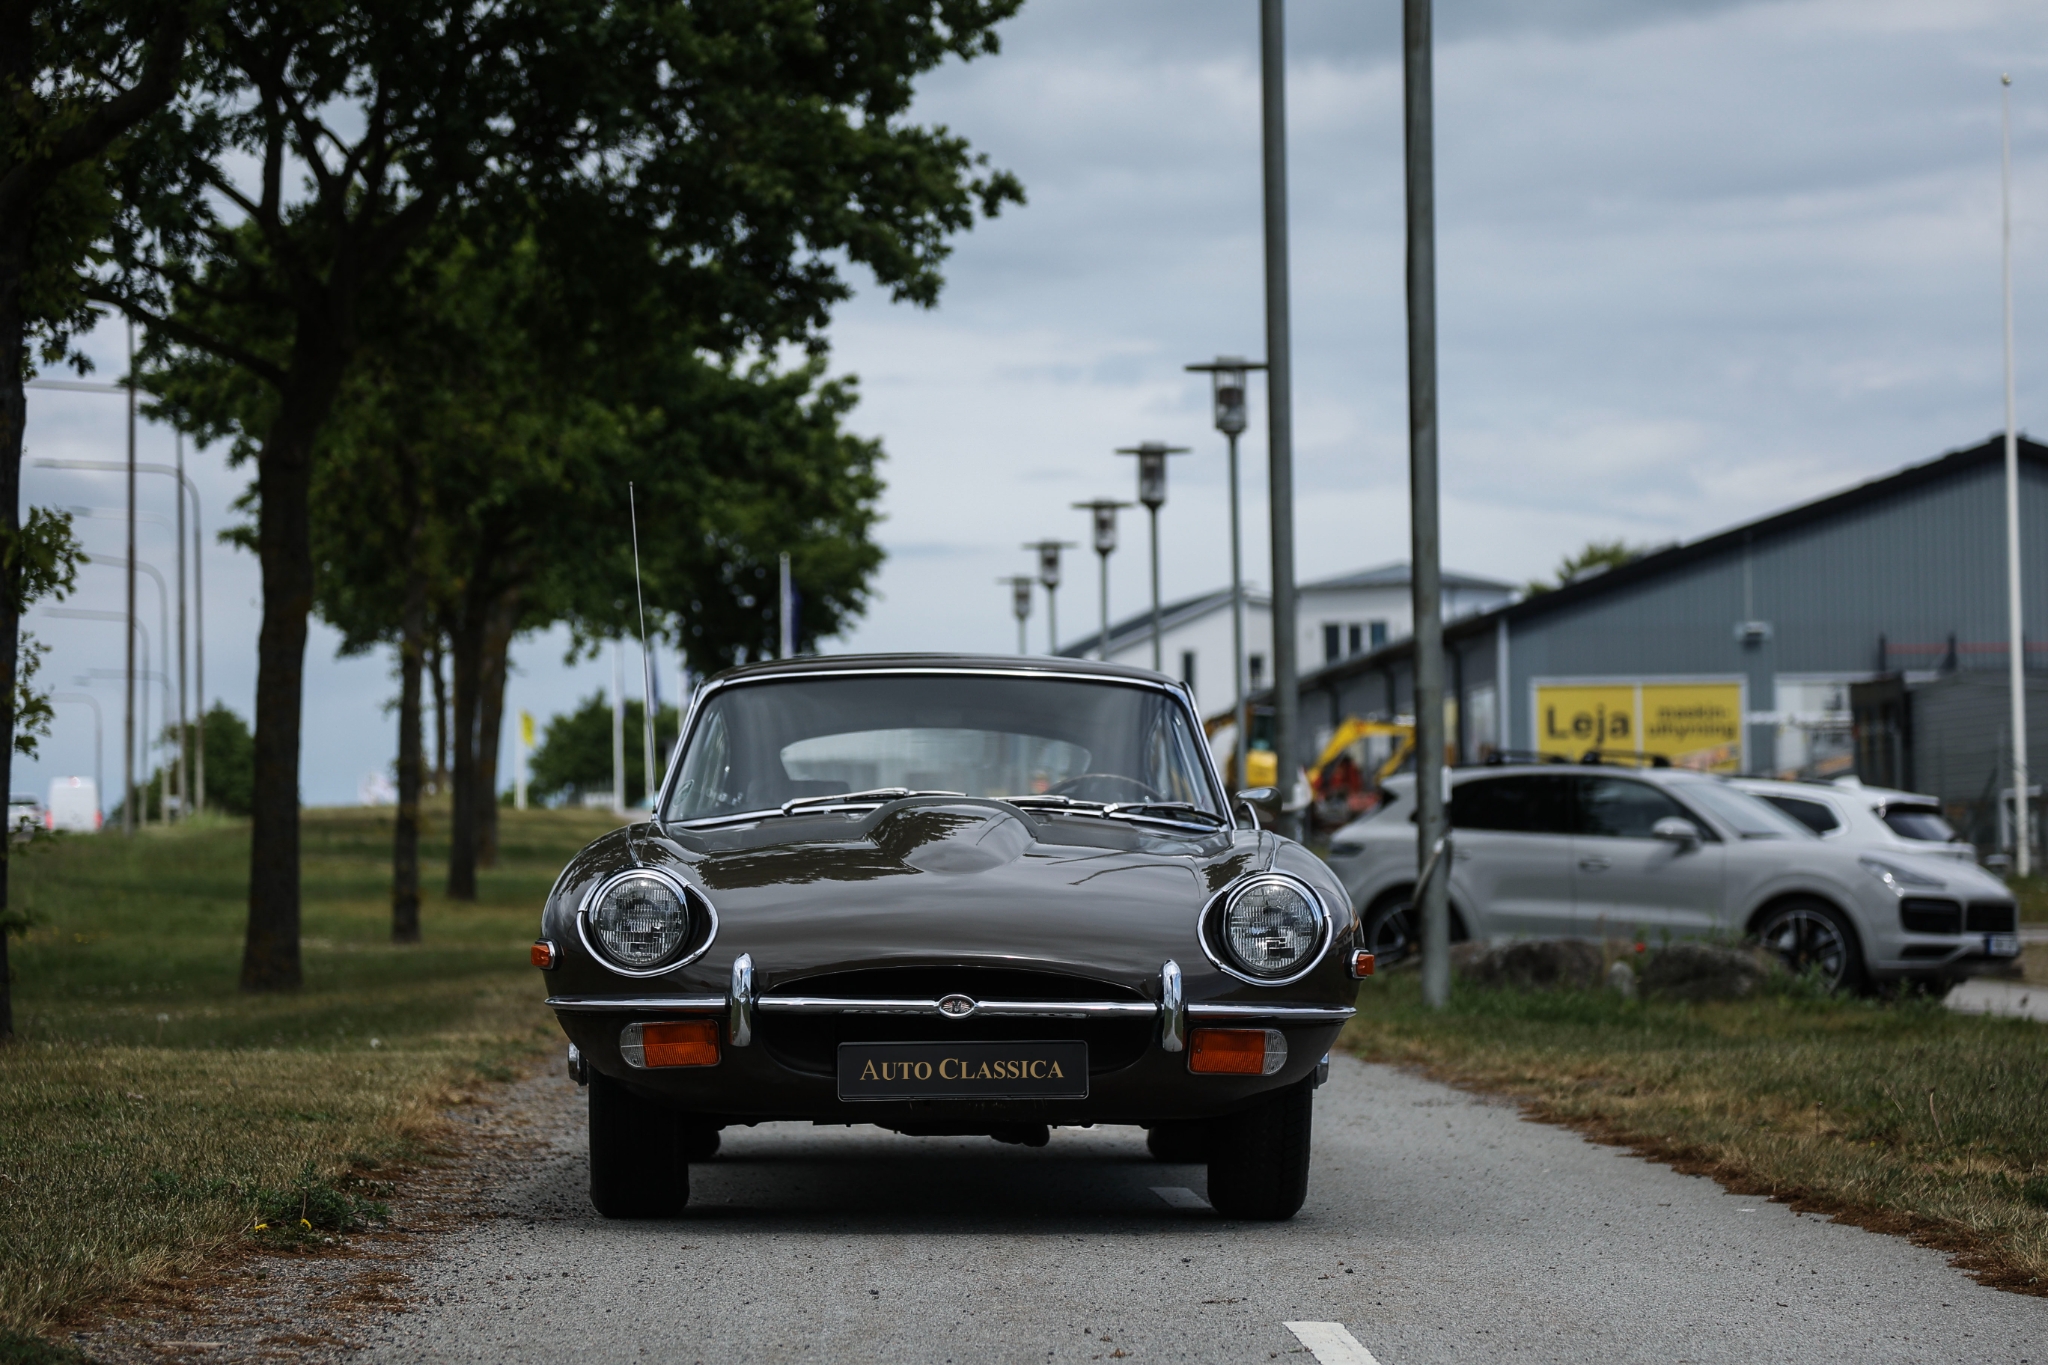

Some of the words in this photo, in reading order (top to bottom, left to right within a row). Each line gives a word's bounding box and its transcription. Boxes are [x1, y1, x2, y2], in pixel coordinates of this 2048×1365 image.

[1547, 703, 1630, 744] Leja
[859, 1059, 933, 1081] AUTO
[938, 1058, 1065, 1080] CLASSICA
